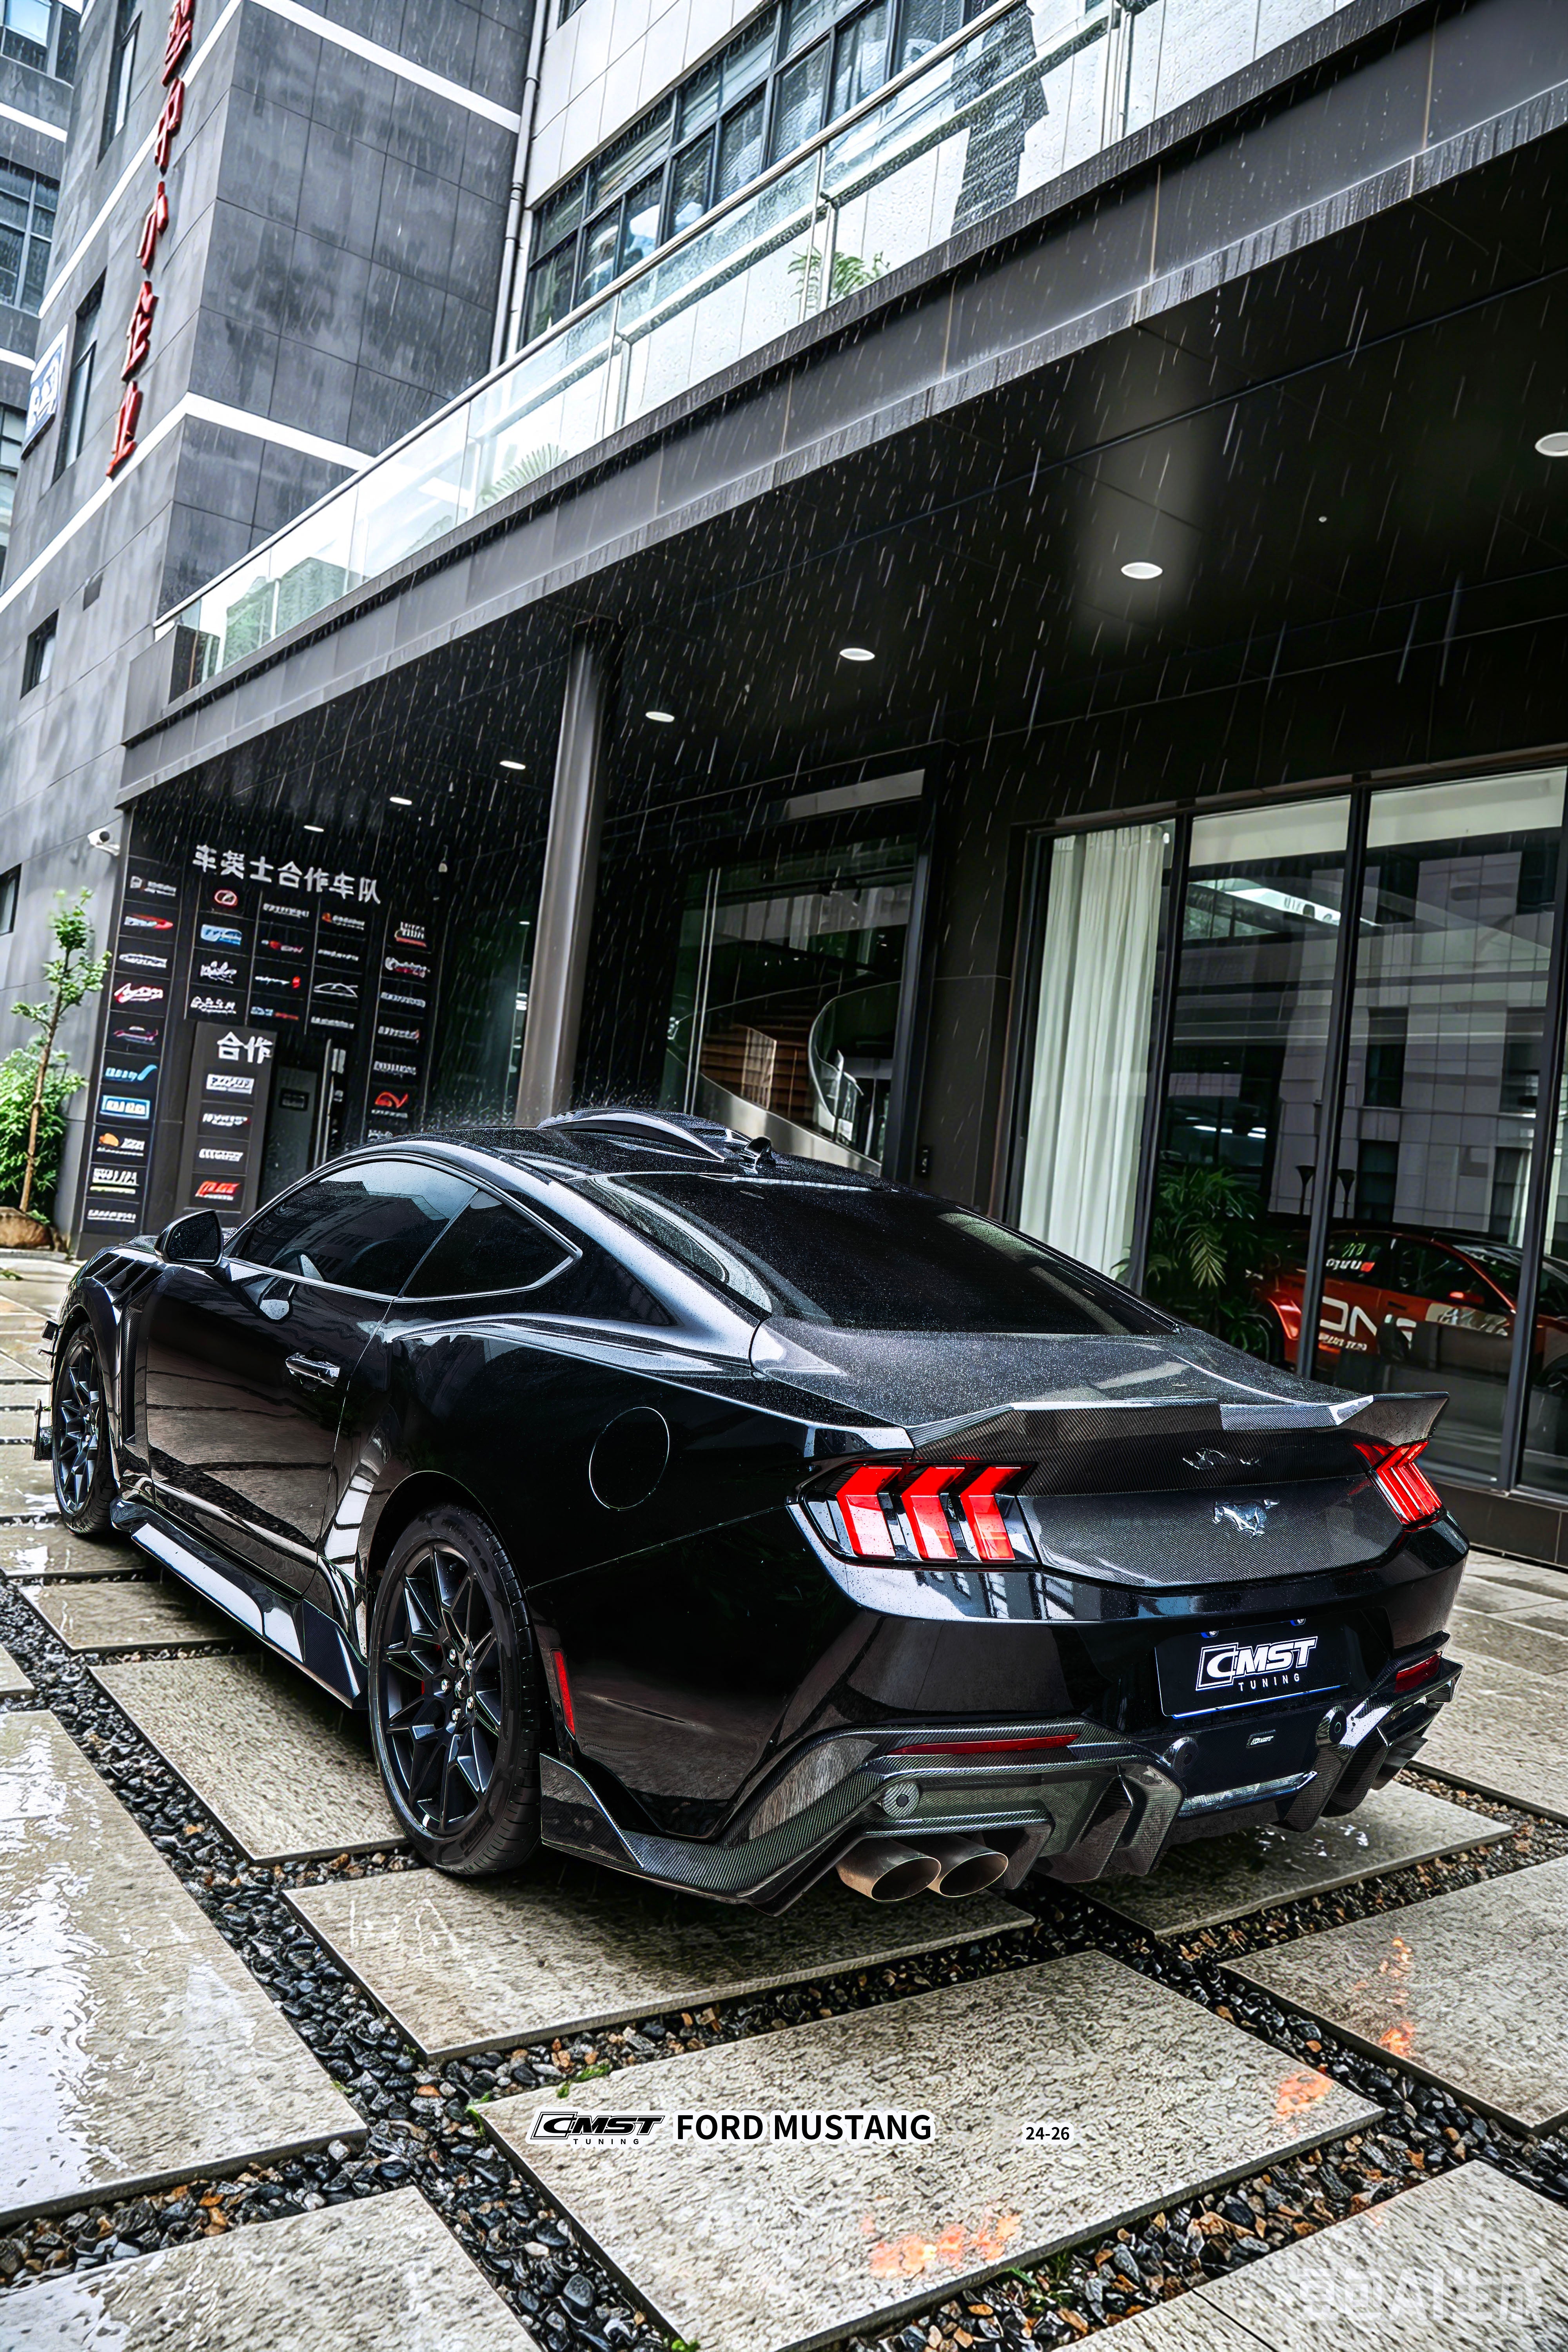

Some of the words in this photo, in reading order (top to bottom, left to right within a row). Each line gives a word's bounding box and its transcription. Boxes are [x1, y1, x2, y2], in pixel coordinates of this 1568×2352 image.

[217, 1031, 273, 1064] 合作
[1198, 1638, 1316, 1687] CMST
[1238, 1673, 1299, 1691] TUNING
